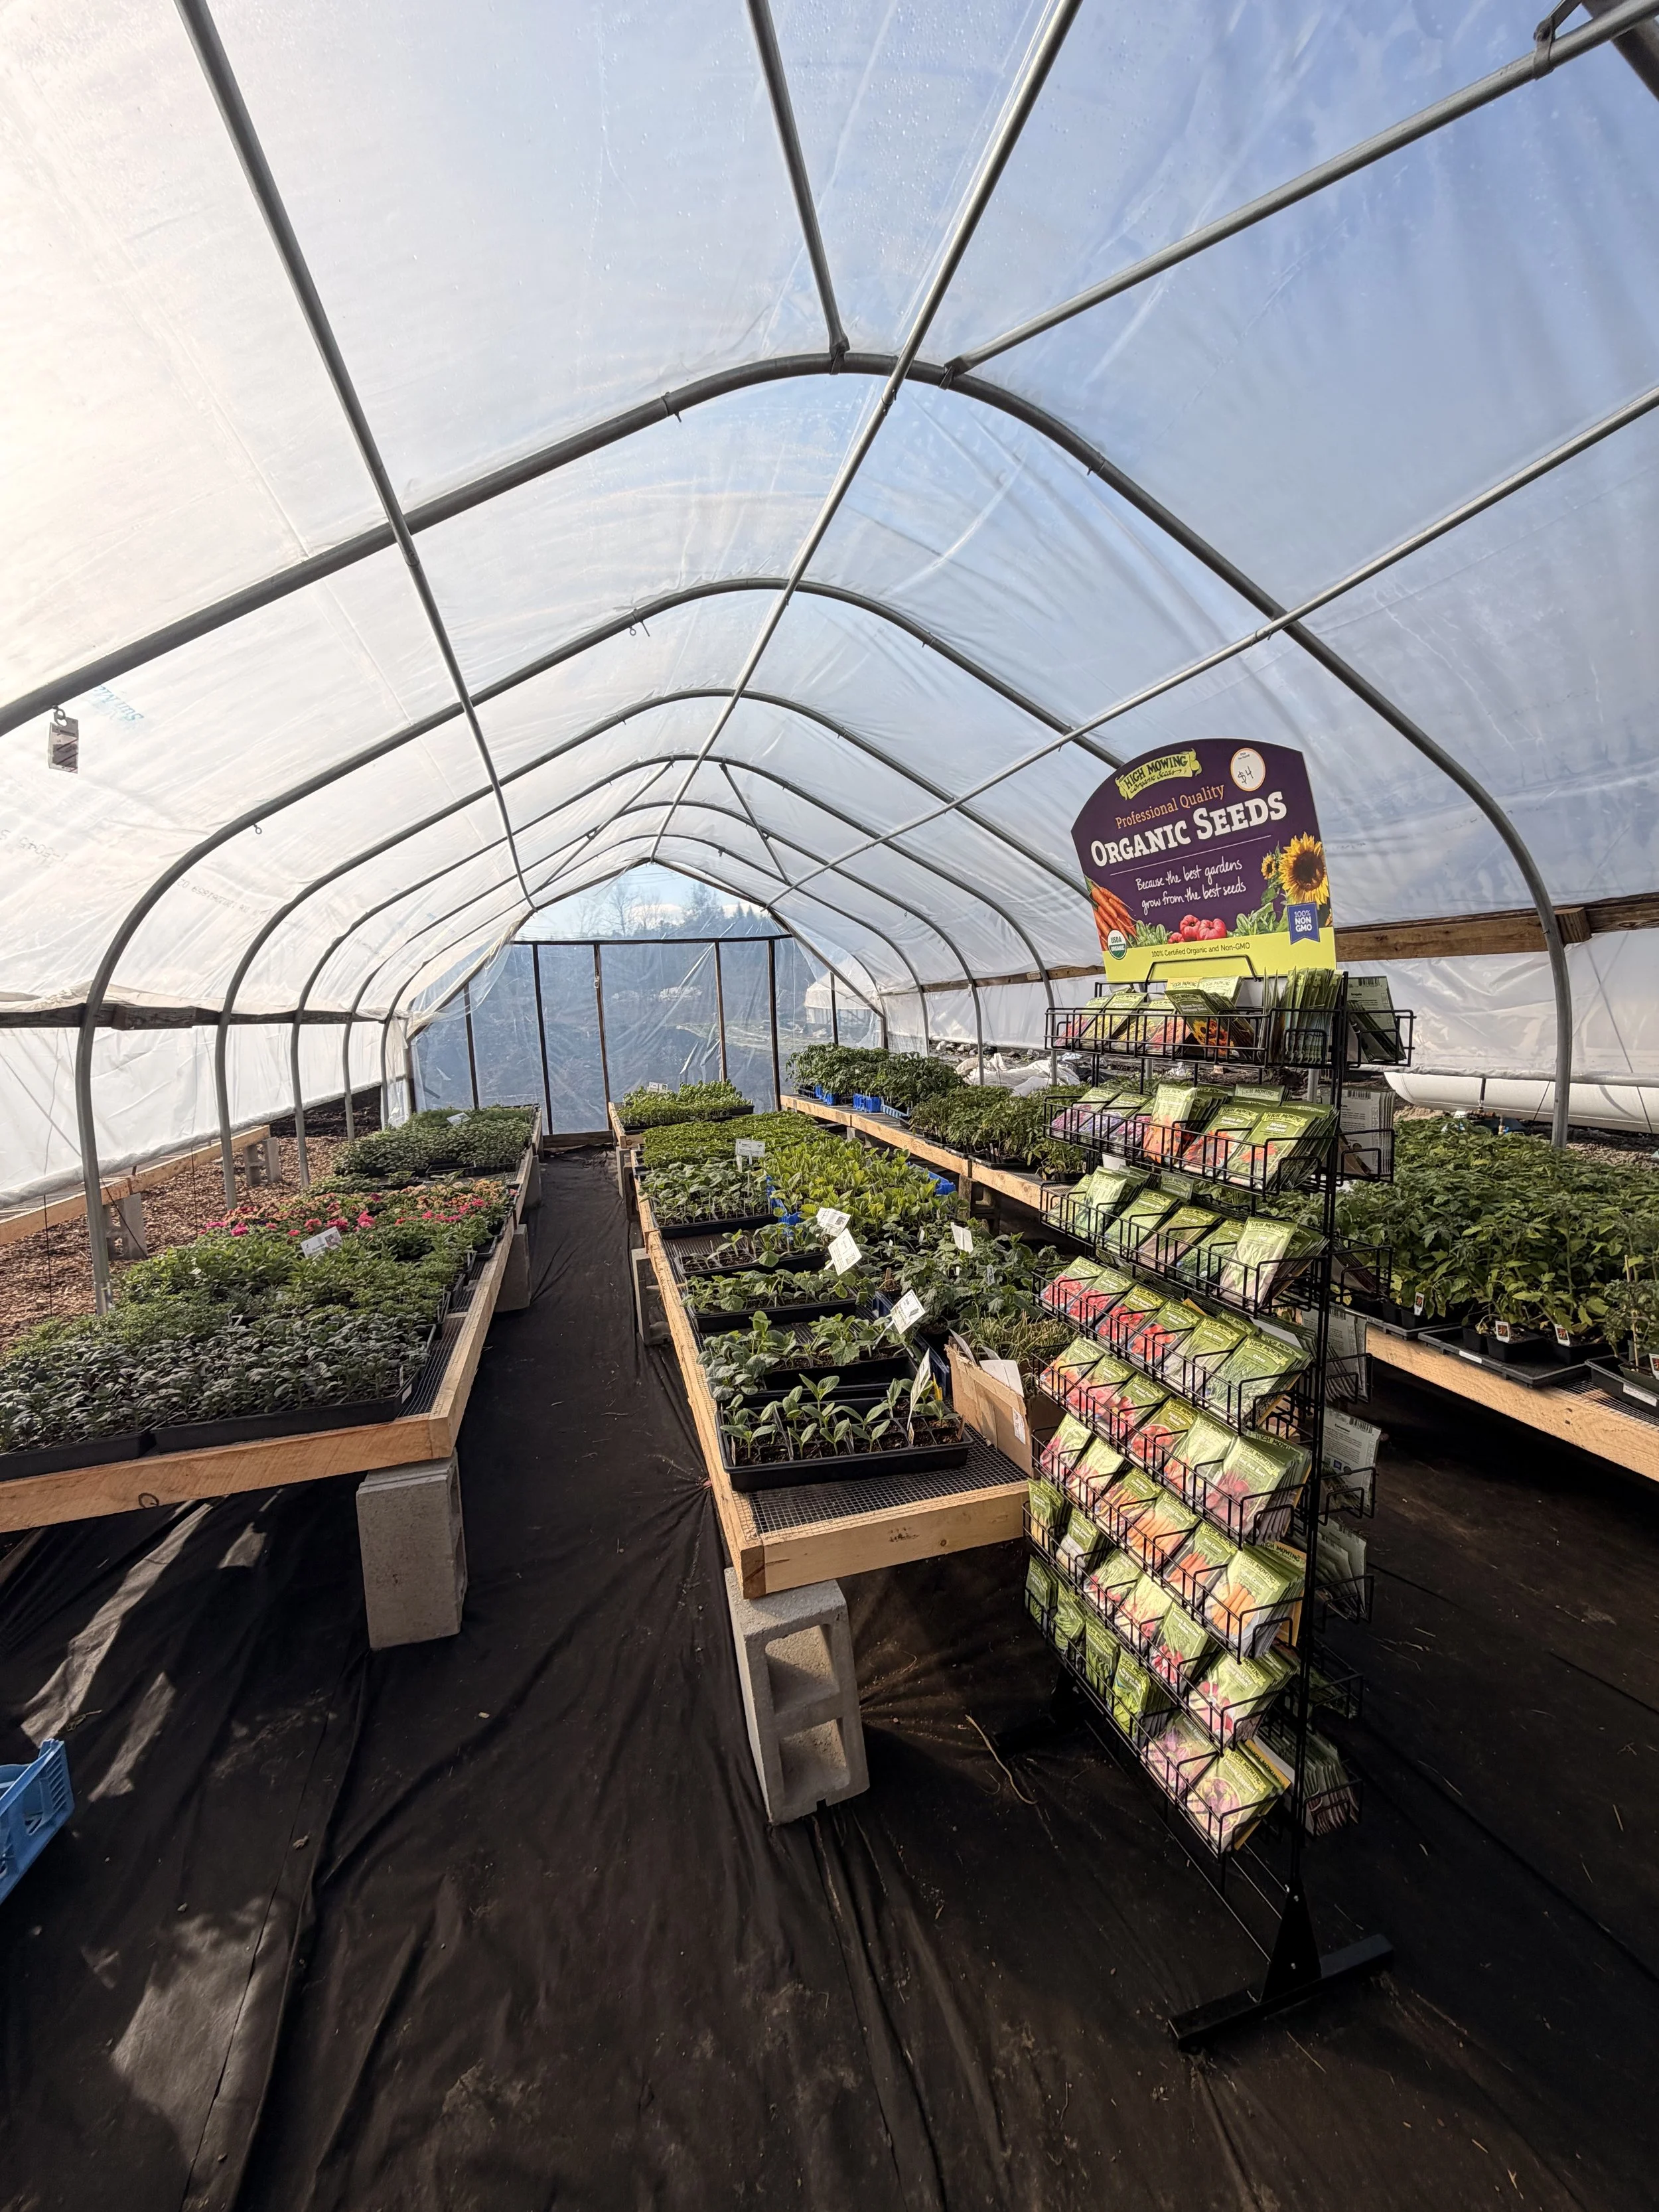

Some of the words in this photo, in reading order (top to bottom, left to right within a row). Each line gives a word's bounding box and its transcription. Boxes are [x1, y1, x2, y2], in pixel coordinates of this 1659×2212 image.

[1123, 769, 1145, 790] HIGH
[1147, 755, 1188, 774] MOWING
[1238, 765, 1254, 784] $4
[1116, 798, 1179, 830] Professional
[1179, 784, 1225, 808] Quality
[1090, 820, 1192, 867] ORGANIC
[1192, 791, 1287, 840] SEEDS
[1135, 877, 1165, 891] Because
[1165, 870, 1181, 885] the
[1183, 865, 1202, 881] best
[1204, 855, 1243, 885] gardens
[1141, 899, 1161, 916] grow
[1161, 891, 1184, 905] from
[1185, 887, 1201, 902] the
[1202, 883, 1222, 900] best
[1223, 876, 1247, 896] seeds
[1295, 916, 1311, 925] NON
[1295, 924, 1312, 932] GMO
[1164, 948, 1186, 956] Certified
[1186, 947, 1208, 956] Organic
[1220, 942, 1250, 951] Non-GMO
[1281, 1114, 1302, 1122] MOWING
[1265, 1223, 1285, 1232] MOWING
[1180, 1307, 1196, 1320] MOWING
[1218, 1323, 1235, 1336] MOWING
[1250, 1340, 1263, 1349] HIGH
[1264, 1345, 1283, 1360] MOWING
[1255, 1433, 1270, 1443] HIGH
[1238, 1456, 1248, 1465] Red
[1246, 1461, 1256, 1471] Ace
[1254, 1467, 1266, 1477] Beet
[1240, 1443, 1255, 1457] HIGH
[1254, 1451, 1276, 1473] MOWING
[1207, 1526, 1217, 1536] HIGH
[1210, 1543, 1222, 1553] Carrot
[1275, 1545, 1301, 1562] MOWING
[1241, 1554, 1255, 1566] HIGH
[1254, 1564, 1277, 1584] MOWING
[1240, 1658, 1263, 1678] MOWING
[1243, 1676, 1253, 1686] Day
[1229, 1751, 1243, 1763] HIGH
[1240, 1762, 1264, 1784] MOWING
[1235, 1773, 1258, 1794] Eggplant
